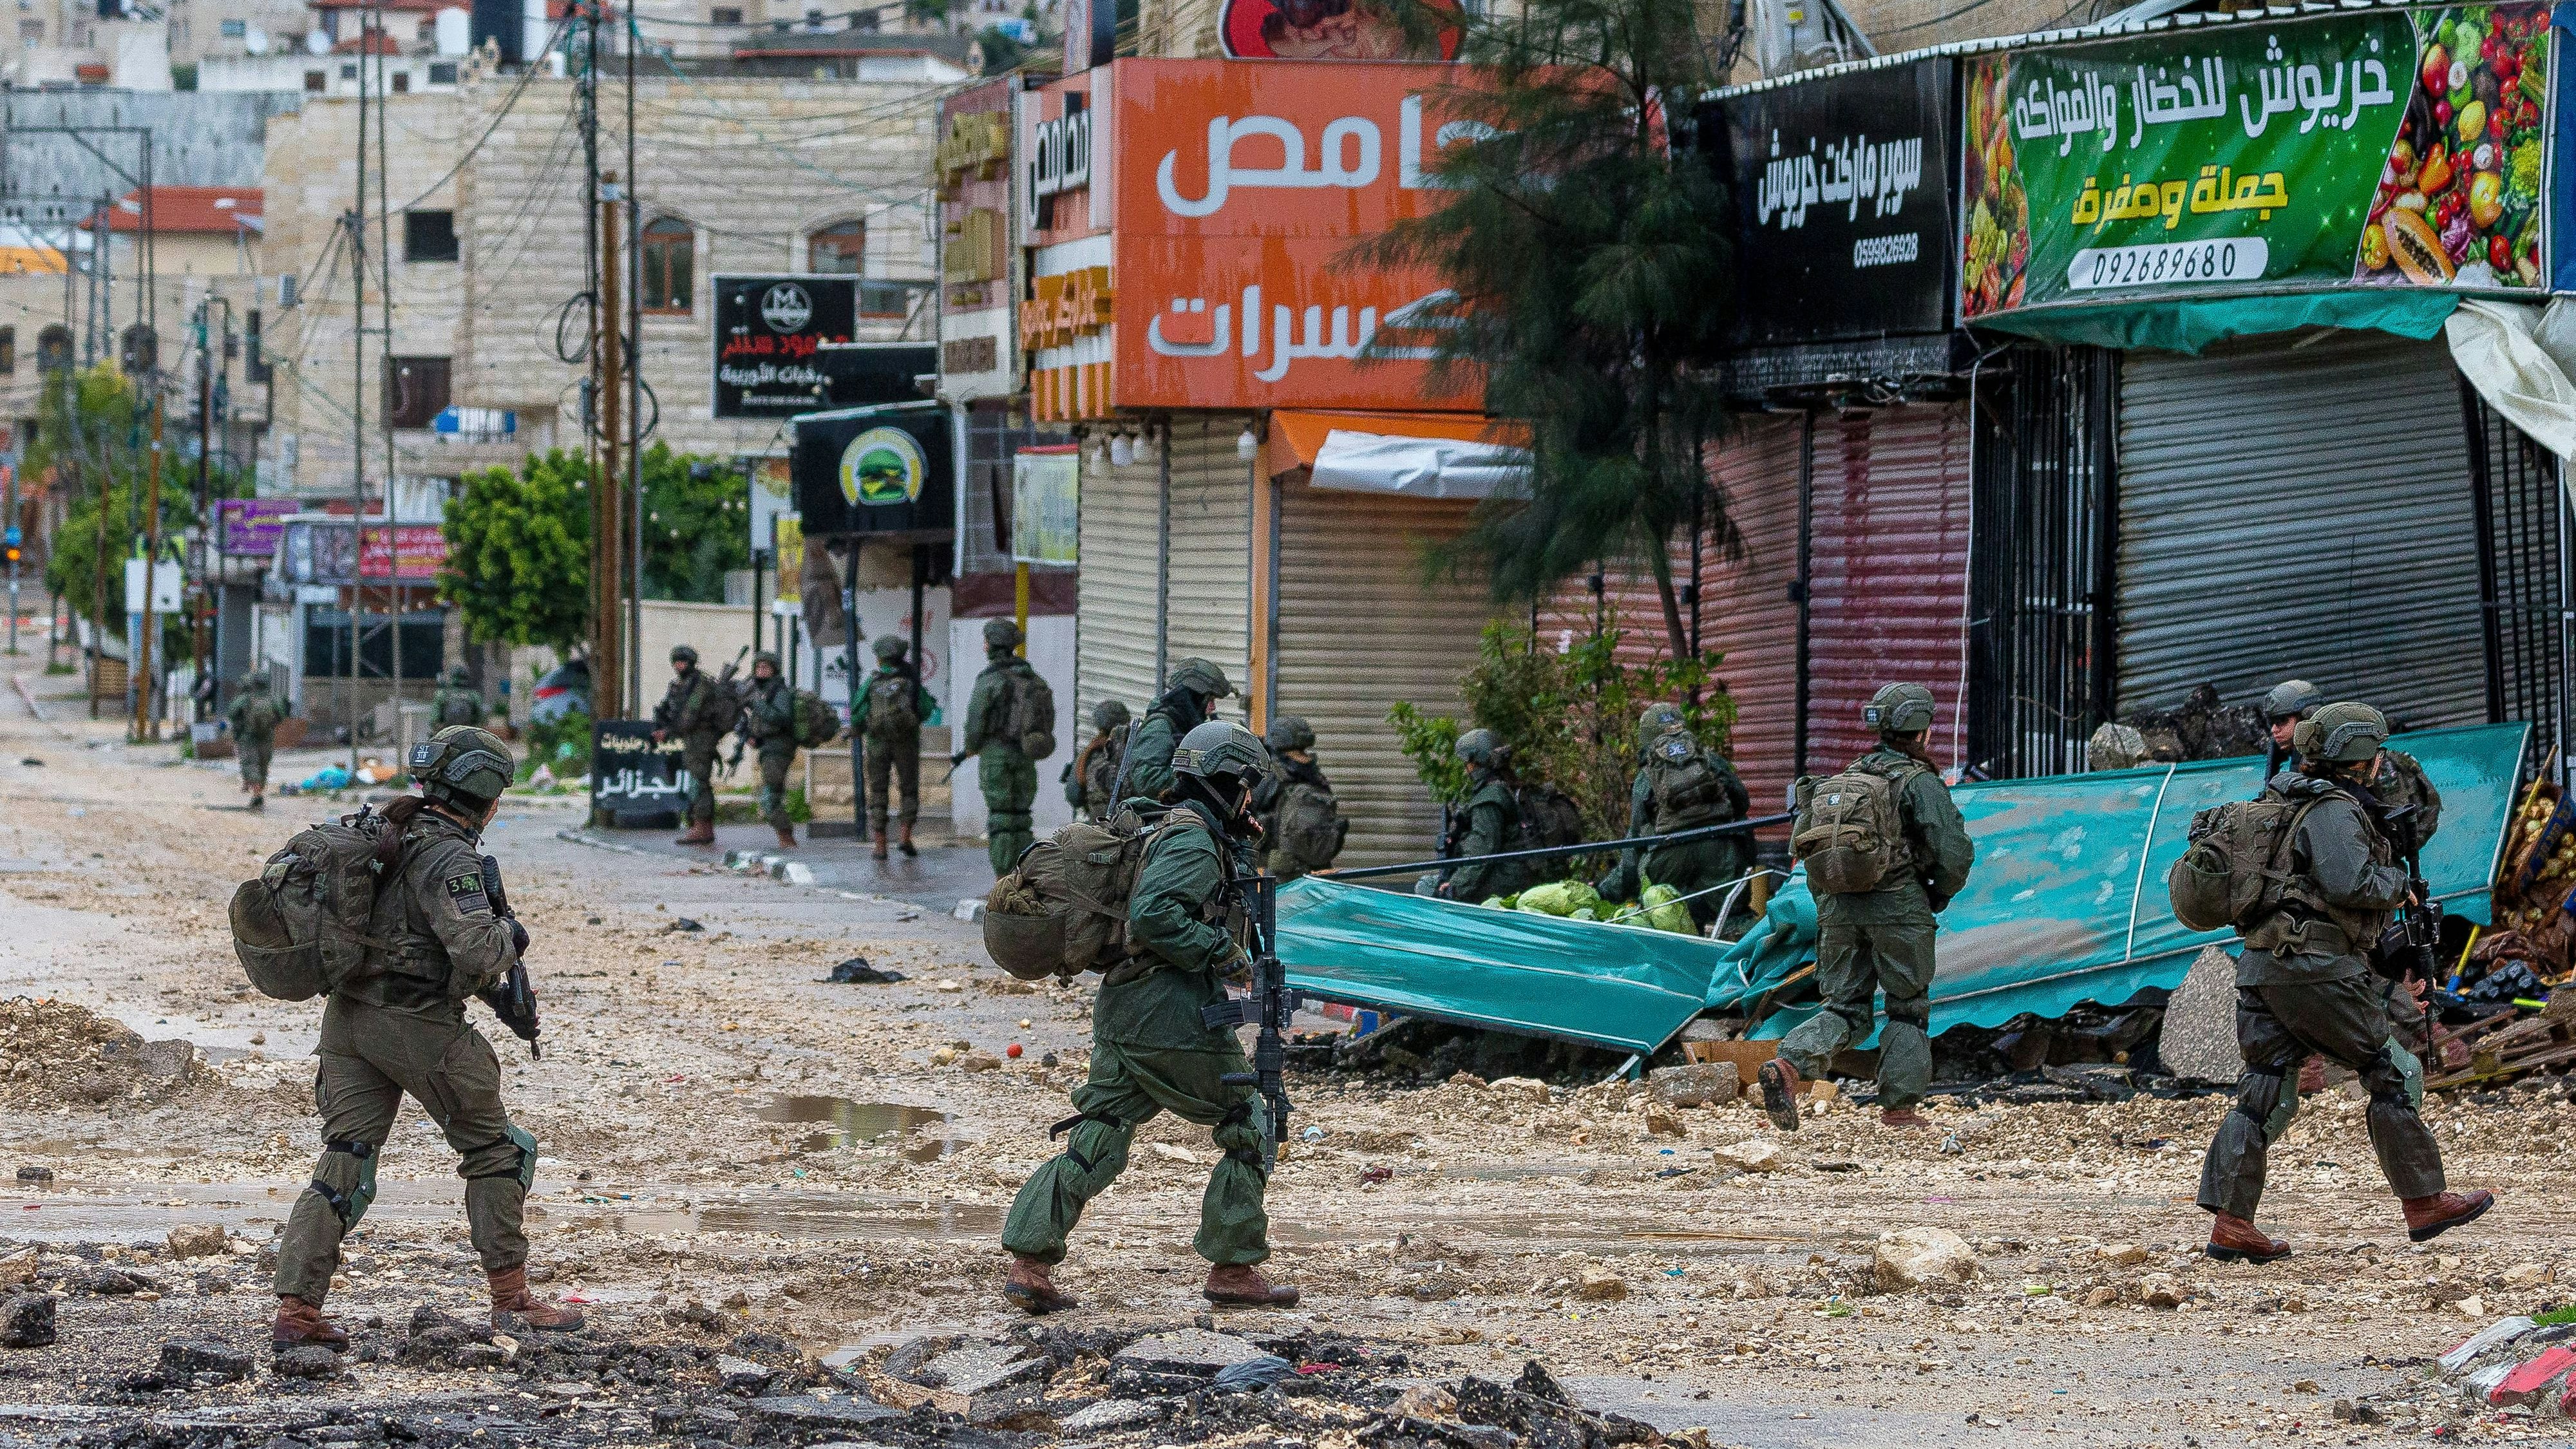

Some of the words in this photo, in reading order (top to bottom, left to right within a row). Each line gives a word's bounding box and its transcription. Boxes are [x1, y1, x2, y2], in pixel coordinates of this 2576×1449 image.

[2014, 71, 2117, 158] والفواكه
[2130, 55, 2227, 150] للخضار
[2239, 34, 2394, 138] خريوش
[1156, 95, 1546, 218] حامص
[1757, 128, 1819, 231] خريوش
[1820, 133, 1877, 223] ماركت
[1875, 137, 1923, 219] سوبر
[2190, 164, 2289, 221] جملة
[2070, 171, 2188, 235] ومفرق
[1853, 231, 1919, 269] 0599826928
[2092, 243, 2237, 285] 092689680
[1148, 287, 1481, 383] كسرات
[595, 767, 691, 799] الجزائر
